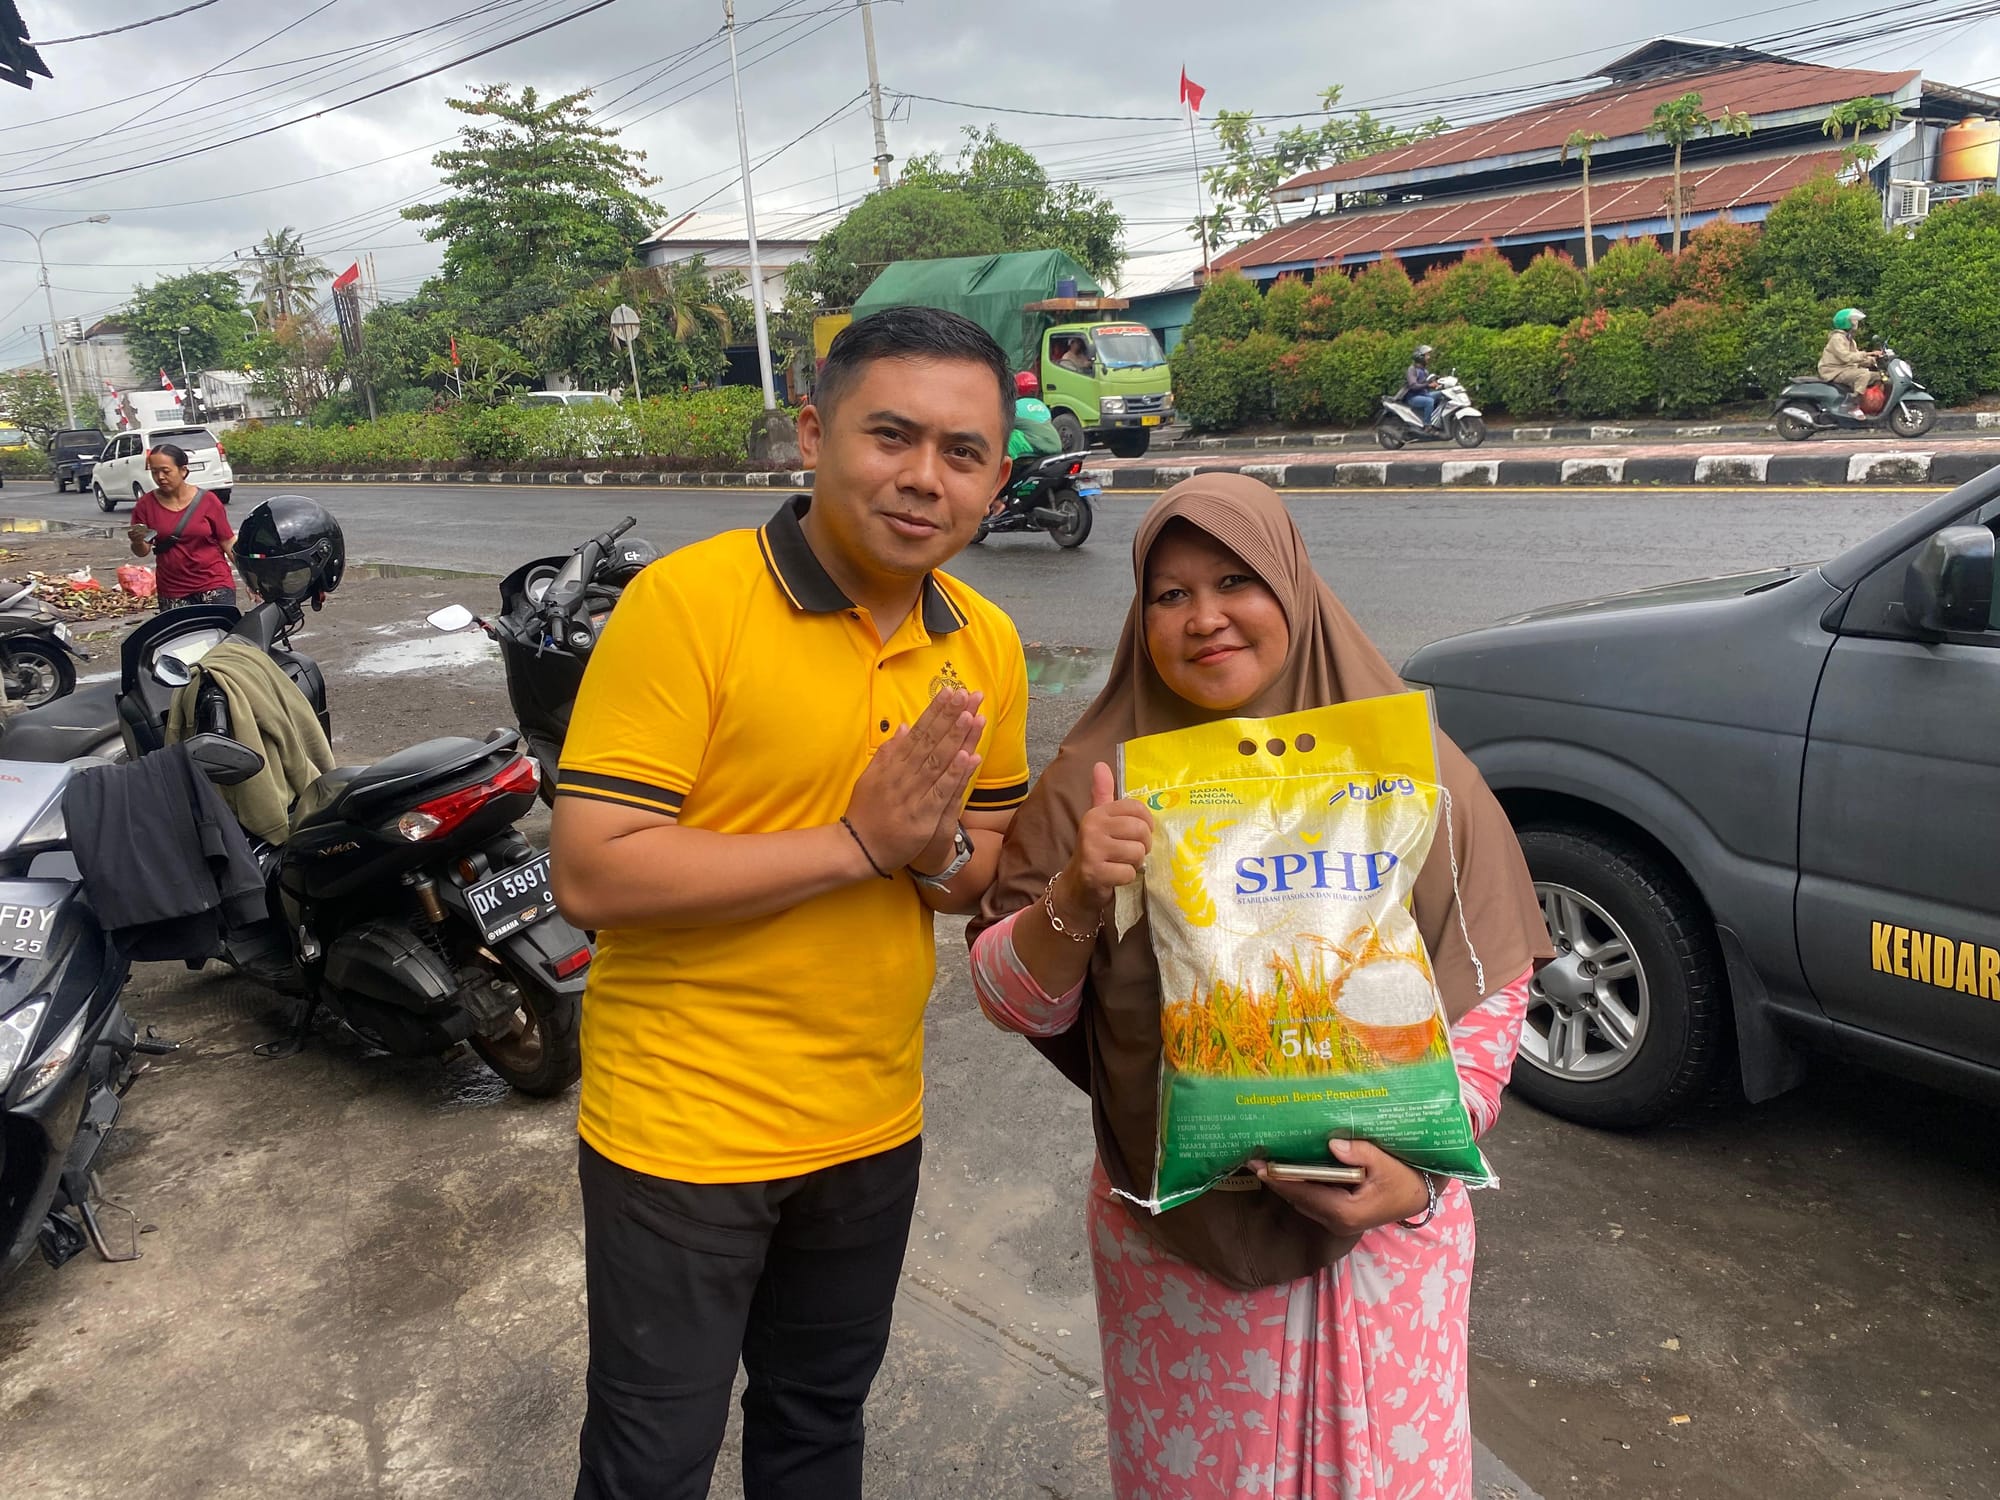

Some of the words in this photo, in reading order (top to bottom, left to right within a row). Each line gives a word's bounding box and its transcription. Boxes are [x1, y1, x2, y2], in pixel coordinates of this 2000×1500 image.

[1348, 778, 1415, 801] bulog
[1235, 850, 1399, 895] SPHP
[473, 887, 502, 915] DK
[502, 863, 547, 898] 5997
[494, 919, 519, 937] YAMAHA
[1870, 920, 2000, 1002] KENDAR
[1281, 1029, 1302, 1057] 5
[1305, 1036, 1333, 1060] kg
[1236, 1093, 1290, 1105] Cadangan
[1293, 1090, 1323, 1102] Beras
[1326, 1085, 1388, 1100] Pemerintah
